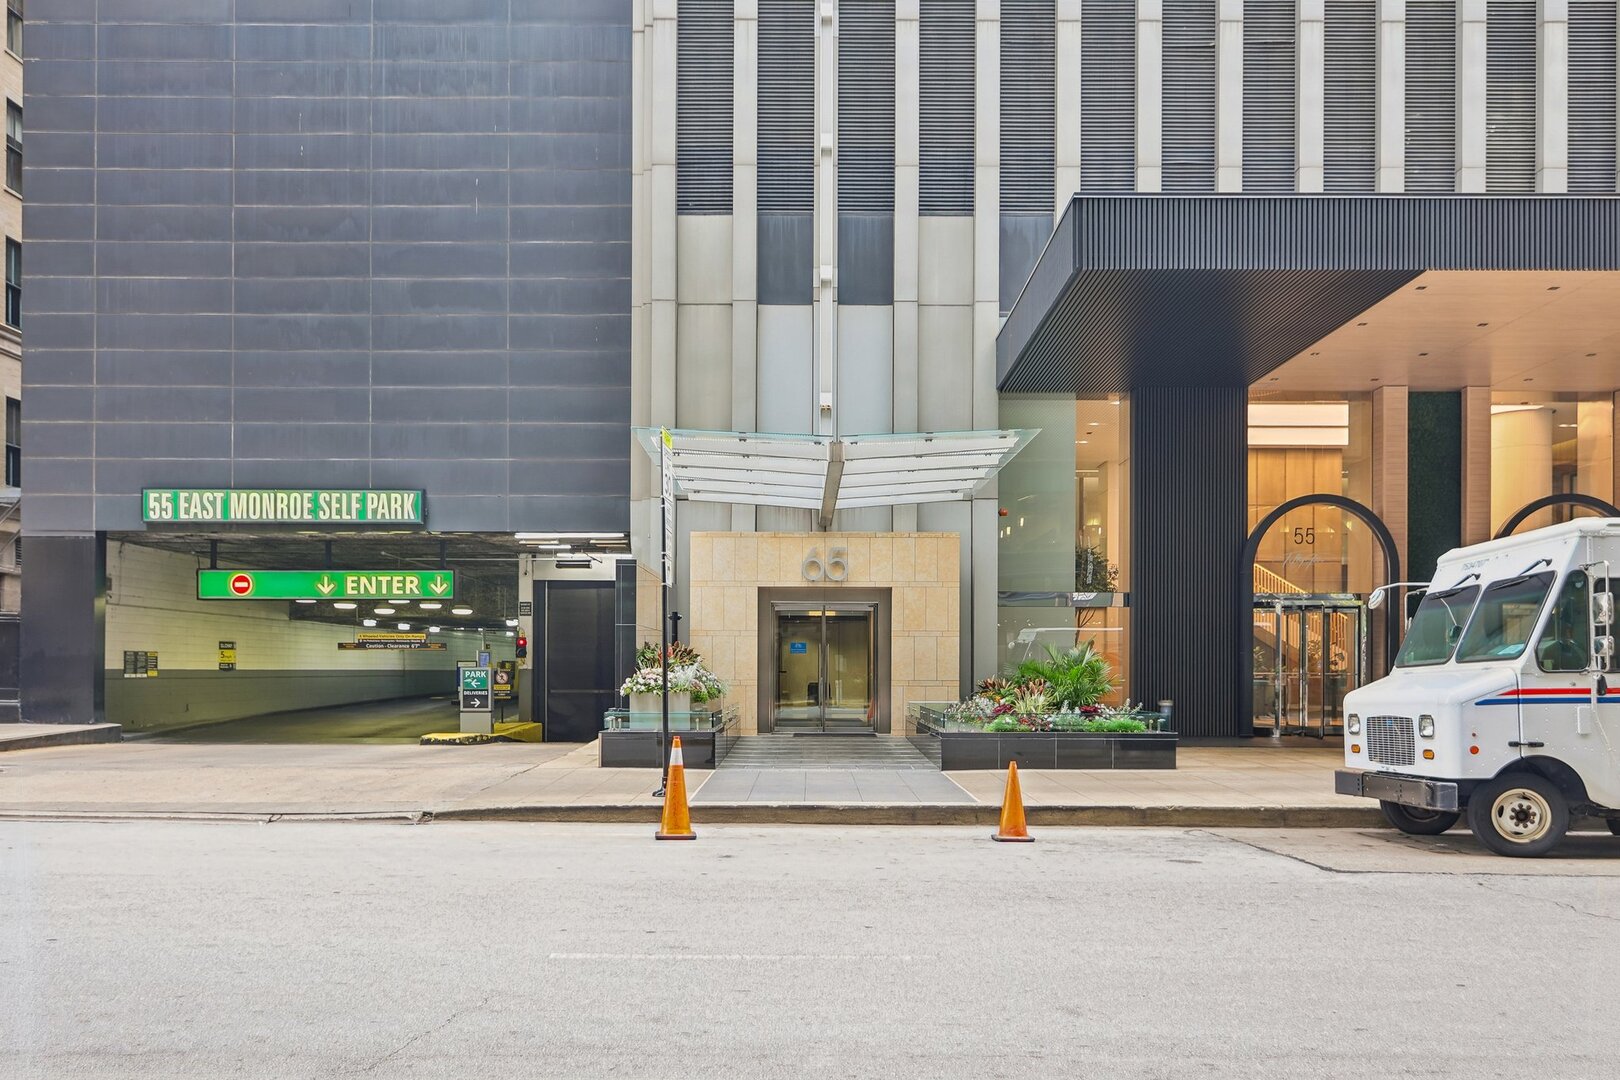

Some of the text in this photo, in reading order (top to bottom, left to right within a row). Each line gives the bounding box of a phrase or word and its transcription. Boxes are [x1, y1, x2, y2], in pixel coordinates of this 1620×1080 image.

[148, 492, 416, 520] 55 EAST MONROE SELF PARK
[1294, 527, 1315, 545] 55
[802, 546, 849, 582] 65
[346, 576, 420, 595] ENTER
[220, 651, 225, 659] 5
